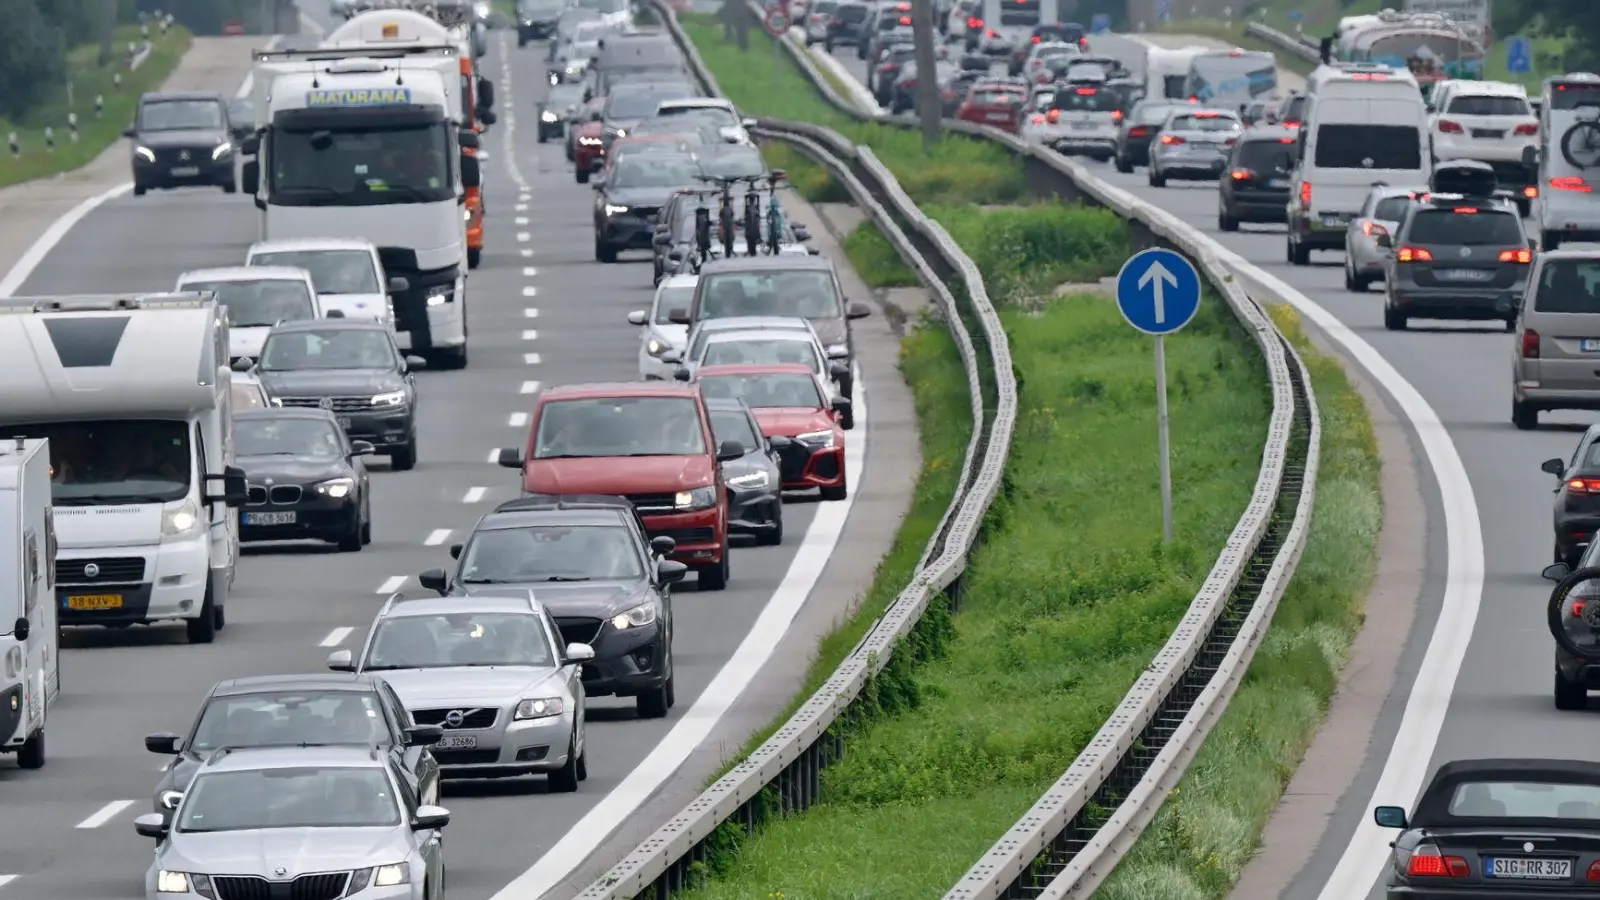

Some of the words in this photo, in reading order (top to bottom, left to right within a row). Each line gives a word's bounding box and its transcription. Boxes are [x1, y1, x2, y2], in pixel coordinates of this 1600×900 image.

[309, 89, 407, 105] MATURANA
[1495, 859, 1519, 874] SIG
[1526, 860, 1543, 875] RR
[1545, 861, 1569, 875] 307
